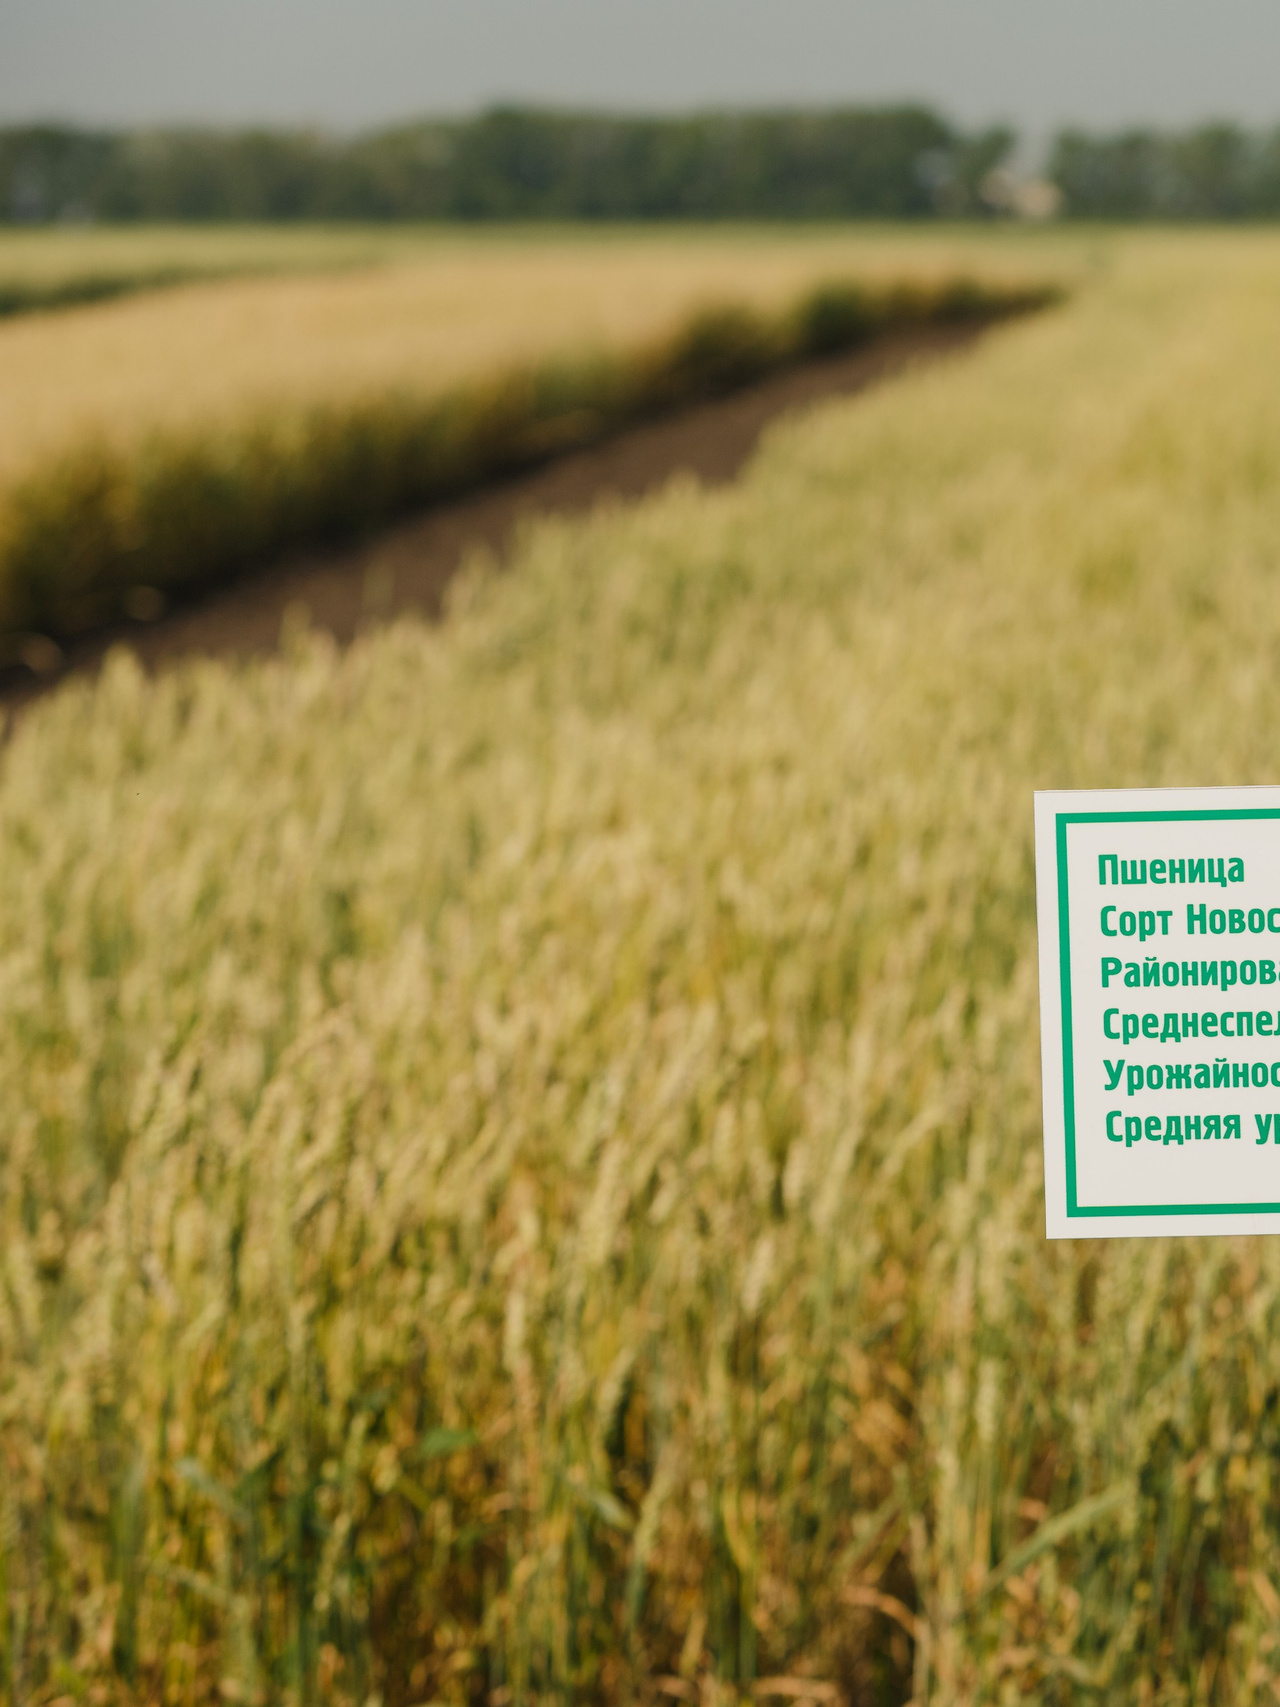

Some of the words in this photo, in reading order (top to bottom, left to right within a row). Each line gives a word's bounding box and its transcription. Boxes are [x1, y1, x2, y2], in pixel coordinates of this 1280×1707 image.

[1097, 853, 1245, 889] Пшеница
[1100, 904, 1174, 943] Сорт
[1105, 1109, 1242, 1148] Средняя
